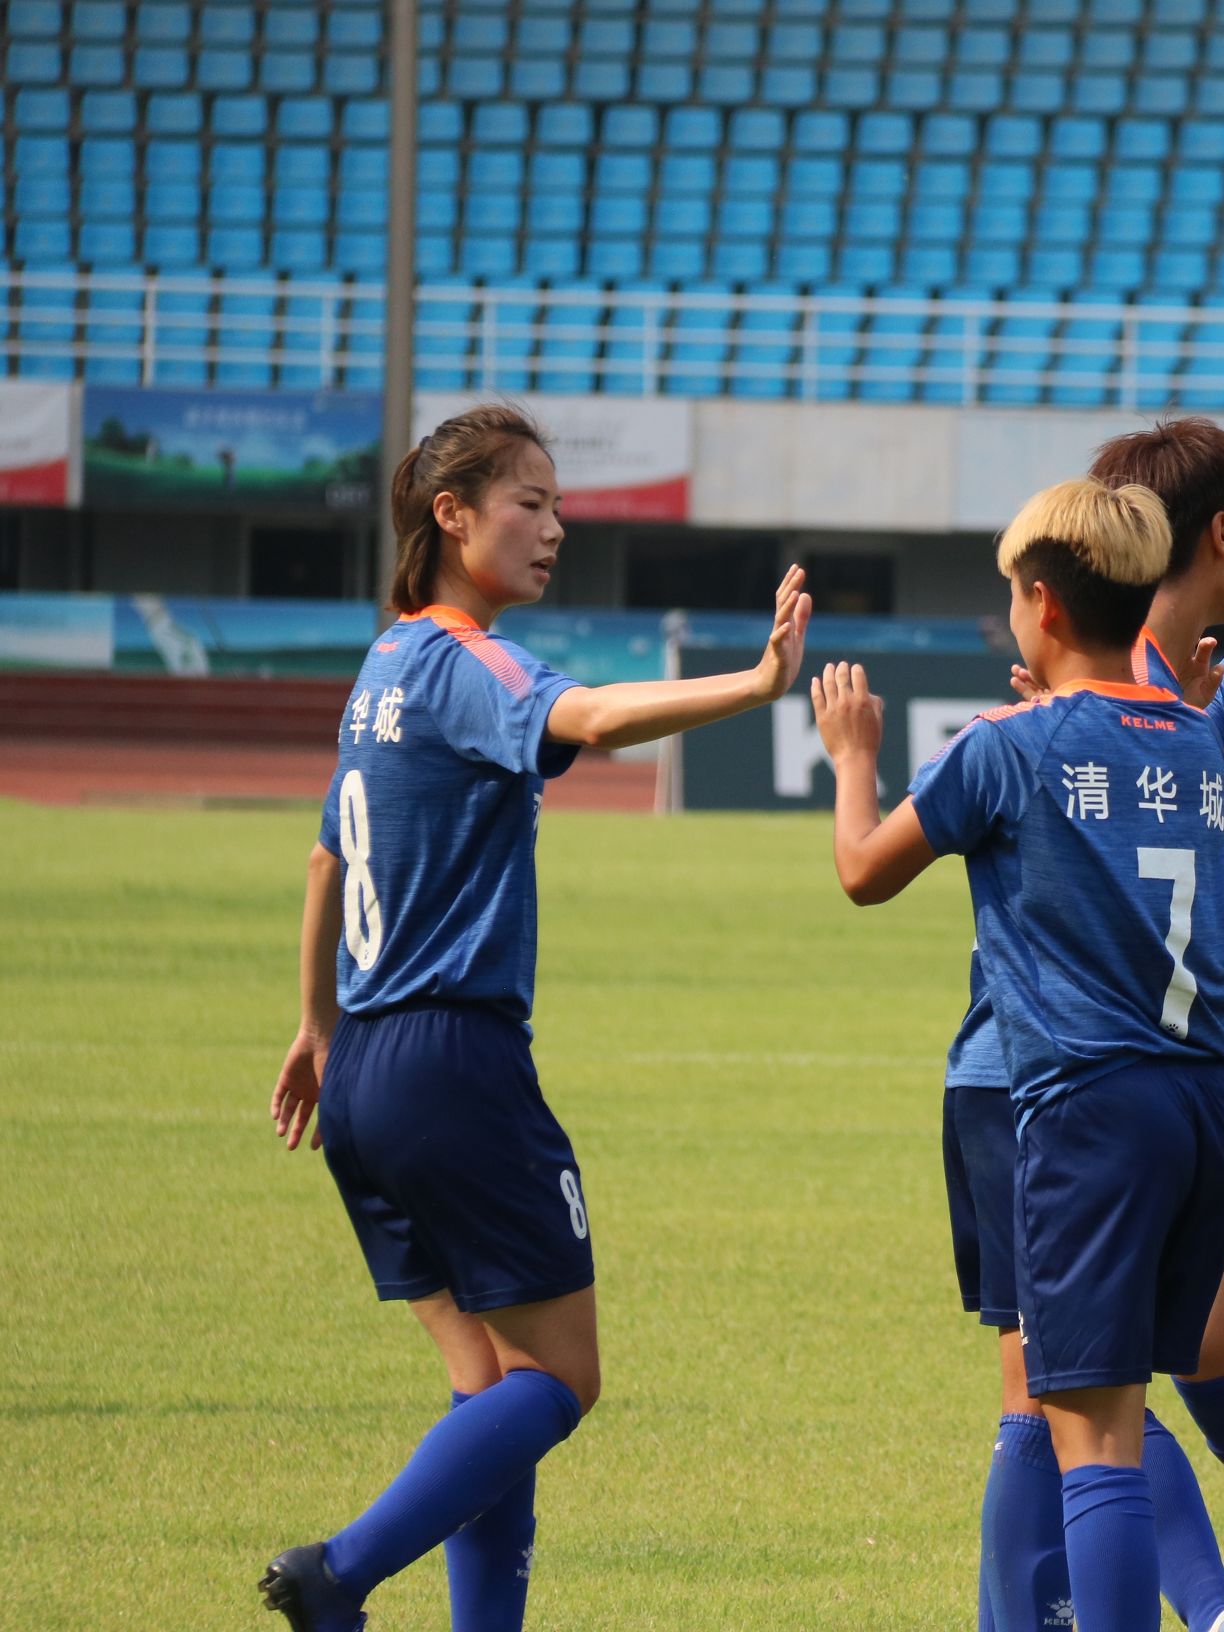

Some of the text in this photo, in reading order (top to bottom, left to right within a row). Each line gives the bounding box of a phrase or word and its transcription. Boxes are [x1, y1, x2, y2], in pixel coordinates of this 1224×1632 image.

[337, 686, 404, 745] 华城
[1120, 715, 1177, 732] KELME
[1061, 761, 1224, 831] 清华城
[339, 769, 382, 971] 8
[1136, 847, 1198, 1040] 7
[559, 1169, 588, 1240] 8
